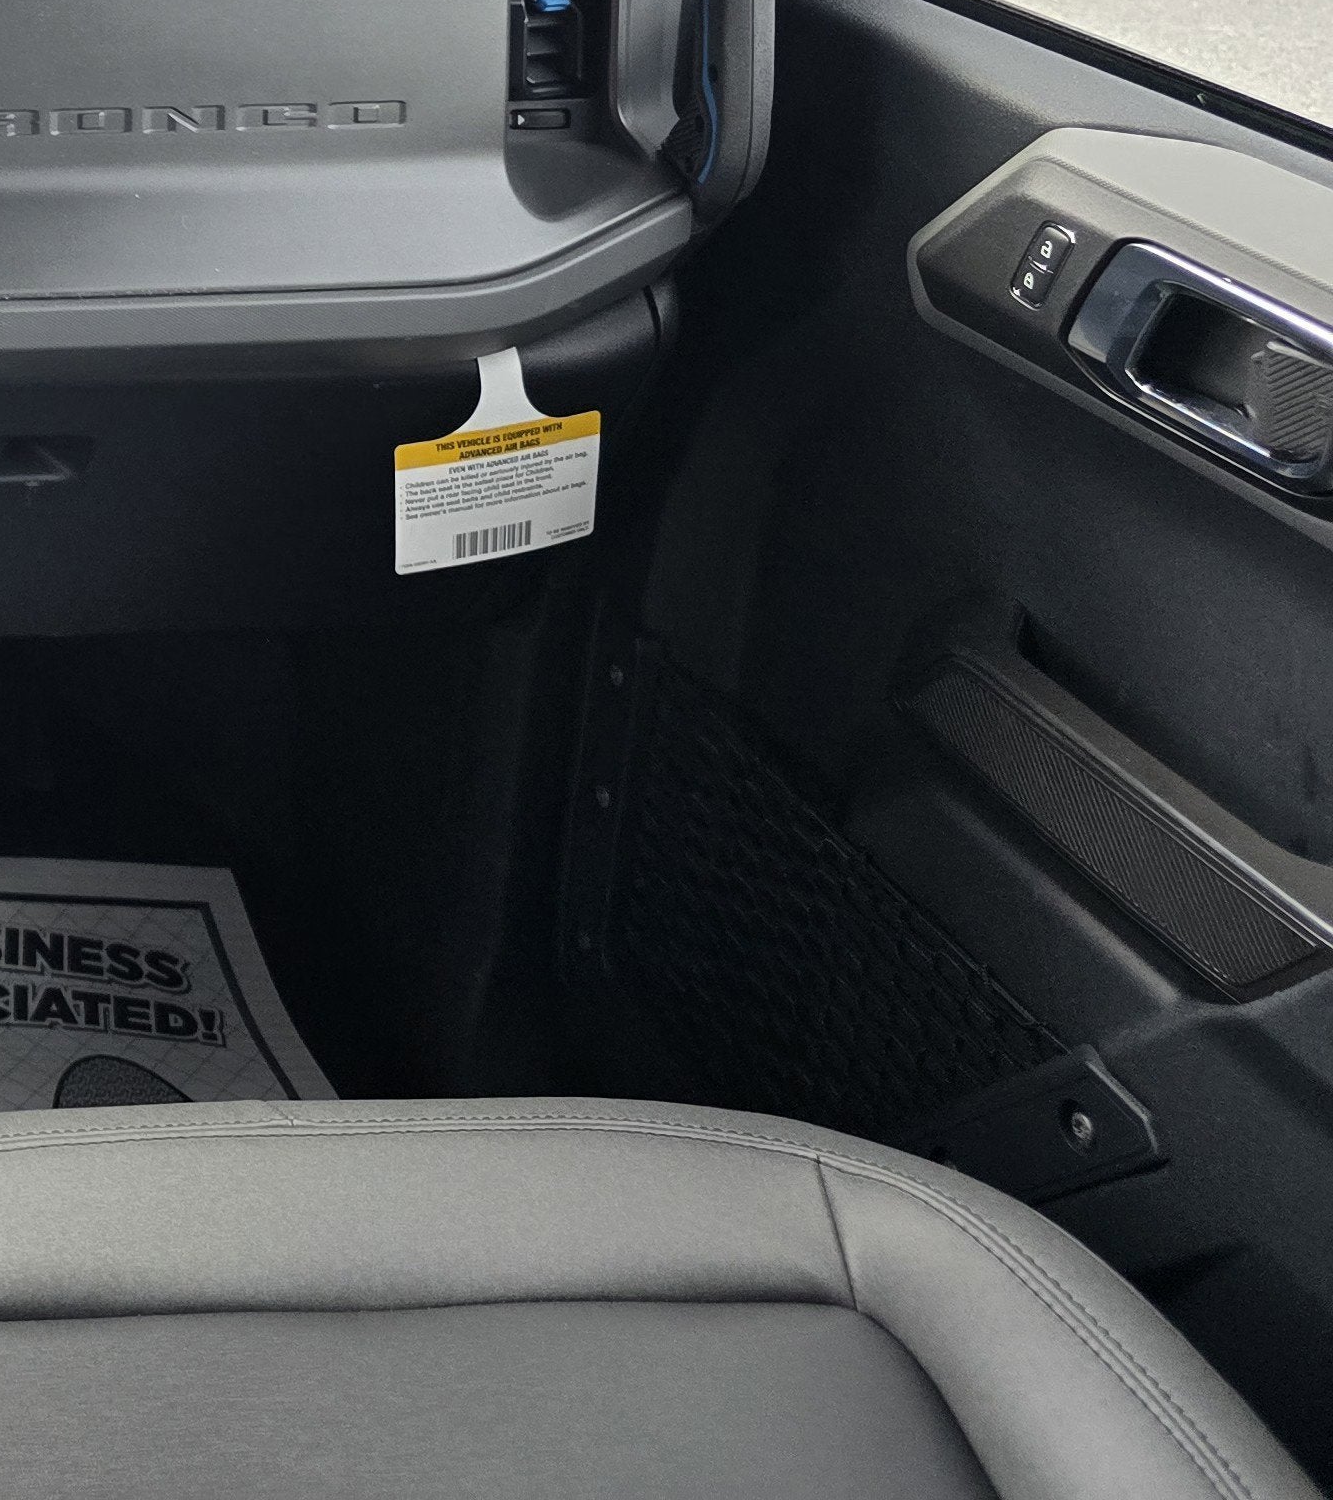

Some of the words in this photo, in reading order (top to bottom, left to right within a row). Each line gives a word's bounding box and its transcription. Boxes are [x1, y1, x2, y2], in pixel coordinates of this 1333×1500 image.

[435, 441, 455, 452] THIS
[457, 435, 491, 450] VEHICLE
[502, 426, 540, 442] EQUIPPED
[542, 422, 563, 434] WITH
[458, 446, 503, 460] ADVANCED
[504, 442, 518, 453] AIR
[520, 438, 541, 450] BAGS
